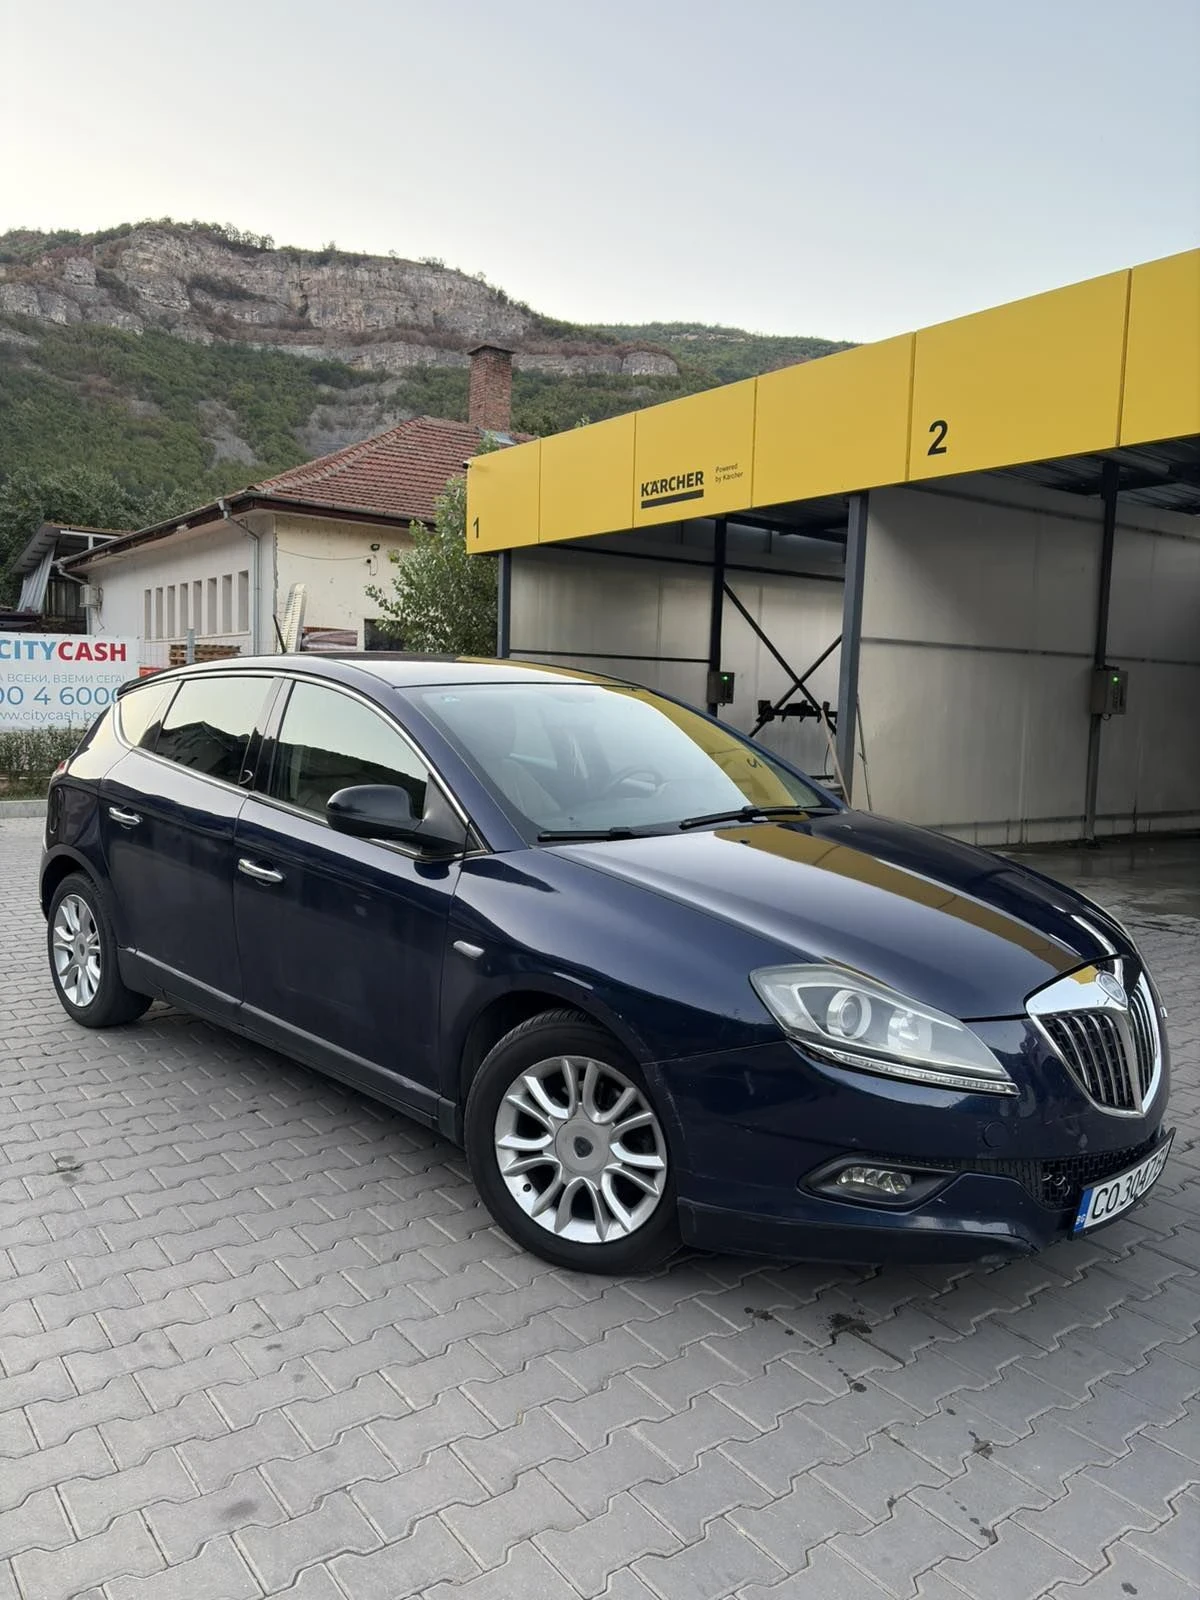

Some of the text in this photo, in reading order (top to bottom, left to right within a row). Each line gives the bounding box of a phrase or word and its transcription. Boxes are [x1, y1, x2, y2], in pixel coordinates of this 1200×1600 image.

[928, 420, 948, 456] 2
[715, 463, 738, 473] Powered
[641, 471, 704, 497] KÄRCHER
[473, 517, 480, 538] 1
[53, 674, 92, 684] ВЗЕМИ
[33, 686, 52, 705] 4
